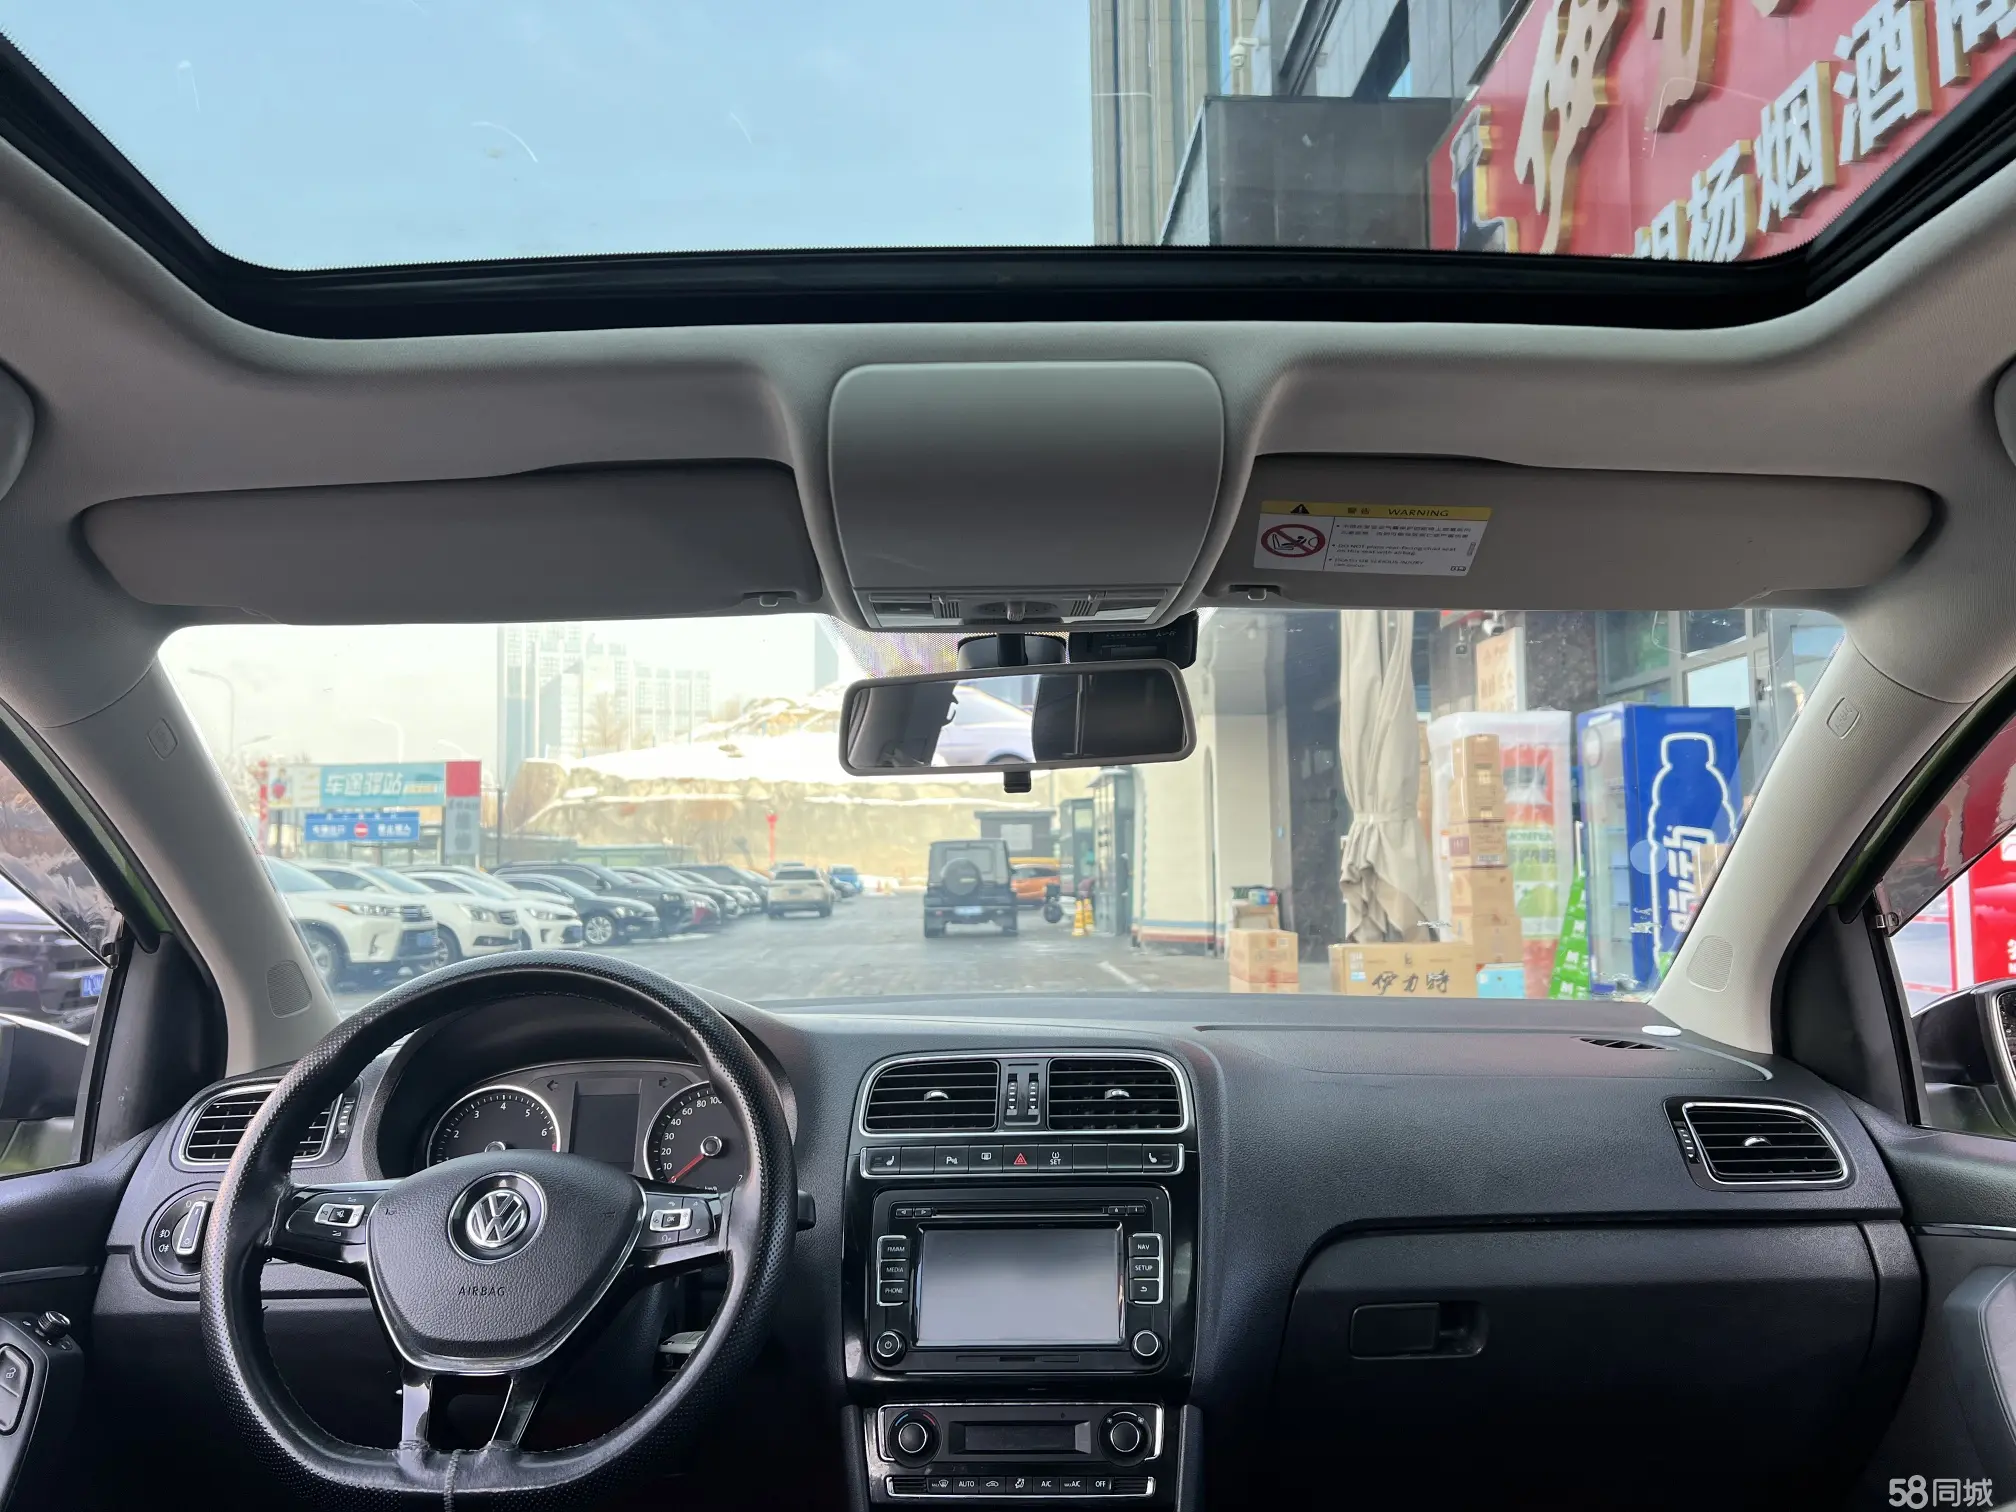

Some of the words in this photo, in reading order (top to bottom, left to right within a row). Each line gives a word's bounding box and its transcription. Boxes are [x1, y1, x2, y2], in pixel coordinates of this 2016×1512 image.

[1388, 507, 1449, 517] WARNING
[500, 1102, 506, 1110] 4
[696, 1100, 707, 1108] 80
[474, 1110, 480, 1119] 3
[525, 1109, 531, 1117] 5
[682, 1107, 693, 1115] 60
[670, 1118, 681, 1126] 40
[453, 1130, 459, 1138] 2
[541, 1128, 548, 1137] 6
[664, 1132, 675, 1140] 30
[661, 1148, 672, 1156] 20
[663, 1162, 672, 1170] 10
[458, 1285, 506, 1296] AIRBAG
